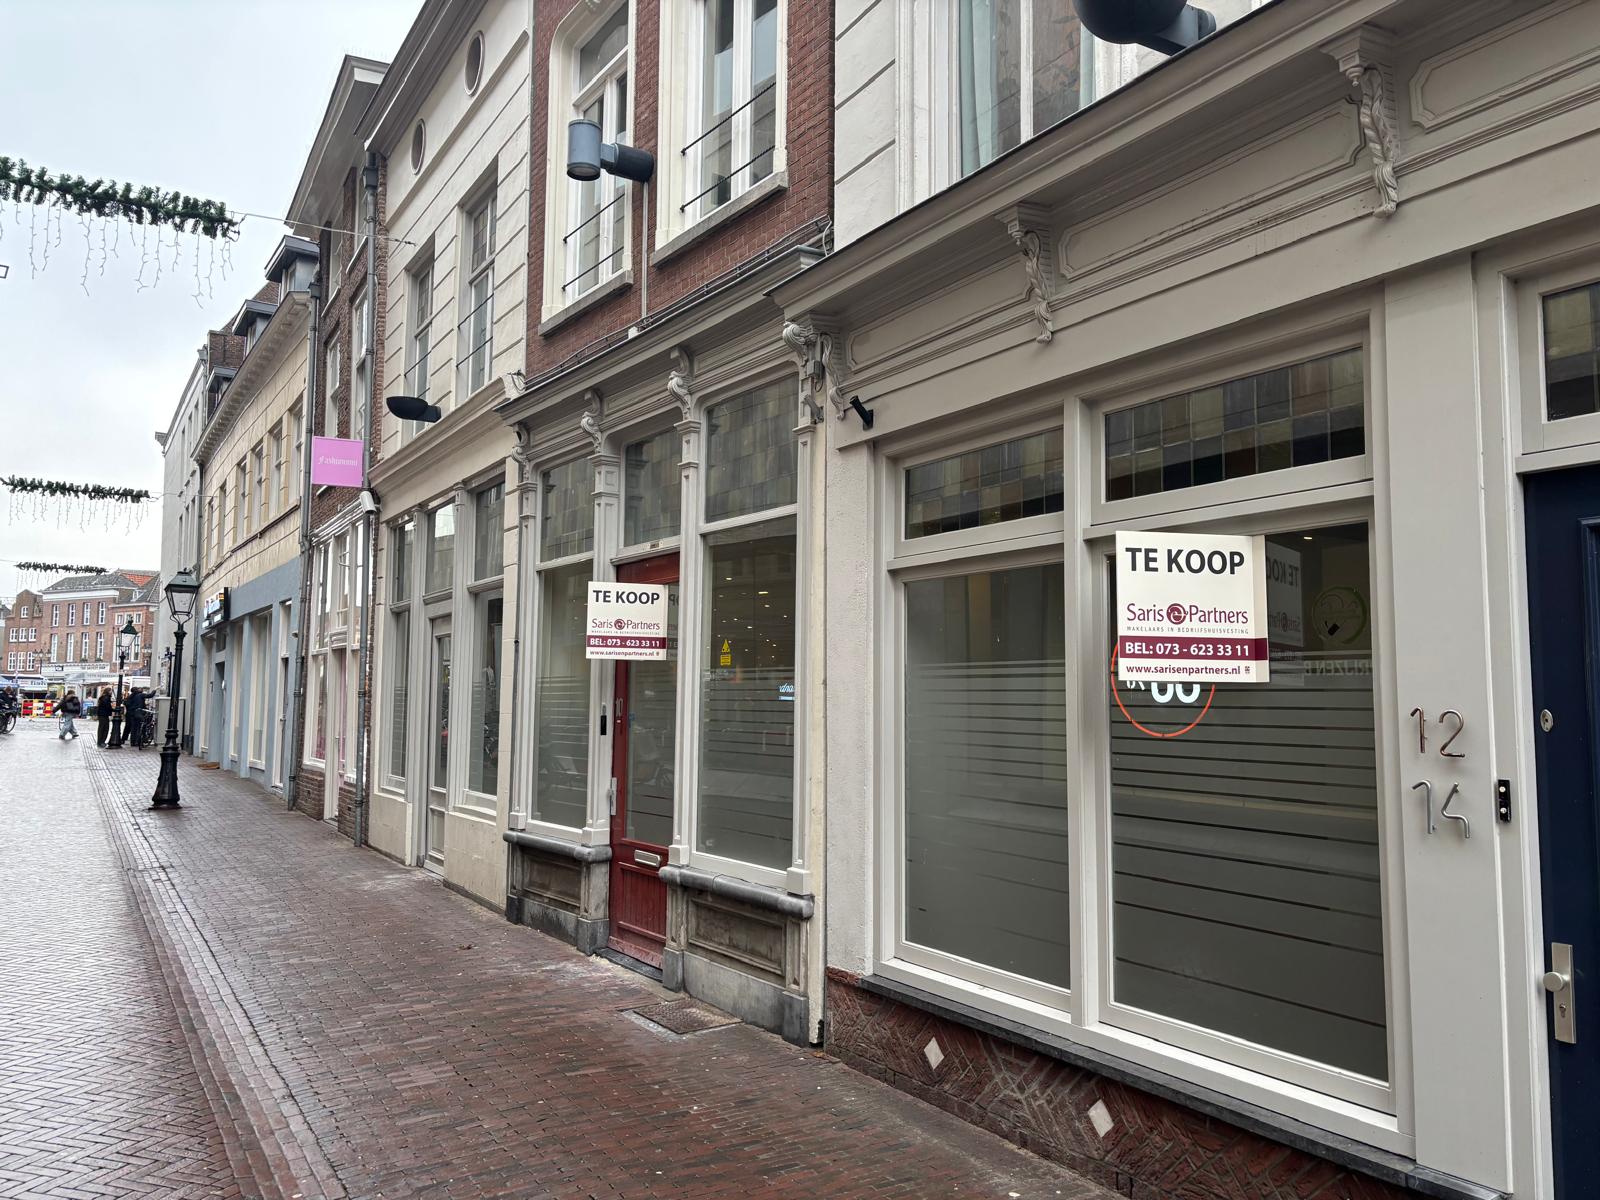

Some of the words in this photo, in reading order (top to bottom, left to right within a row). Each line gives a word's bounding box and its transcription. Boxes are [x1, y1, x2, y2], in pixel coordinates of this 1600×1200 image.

[1125, 547, 1159, 572] TE
[1167, 549, 1245, 575] KOOP
[593, 590, 612, 603] TE
[616, 591, 660, 604] KOOP
[1126, 603, 1165, 621] Saris
[1189, 604, 1249, 624] Partners
[591, 618, 613, 629] Saris
[626, 620, 660, 631] Partners
[590, 638, 606, 646] BEL:
[607, 638, 621, 646] 073
[626, 639, 640, 647] 623
[1125, 642, 1153, 654] BEL:
[1156, 643, 1180, 655] 073
[1190, 644, 1214, 656] 623
[1217, 645, 1232, 656] 33
[1235, 645, 1249, 656] 11
[1126, 664, 1240, 676] www.sarisenpartners.nl
[1410, 706, 1465, 758] 12
[1411, 779, 1470, 838] 14
